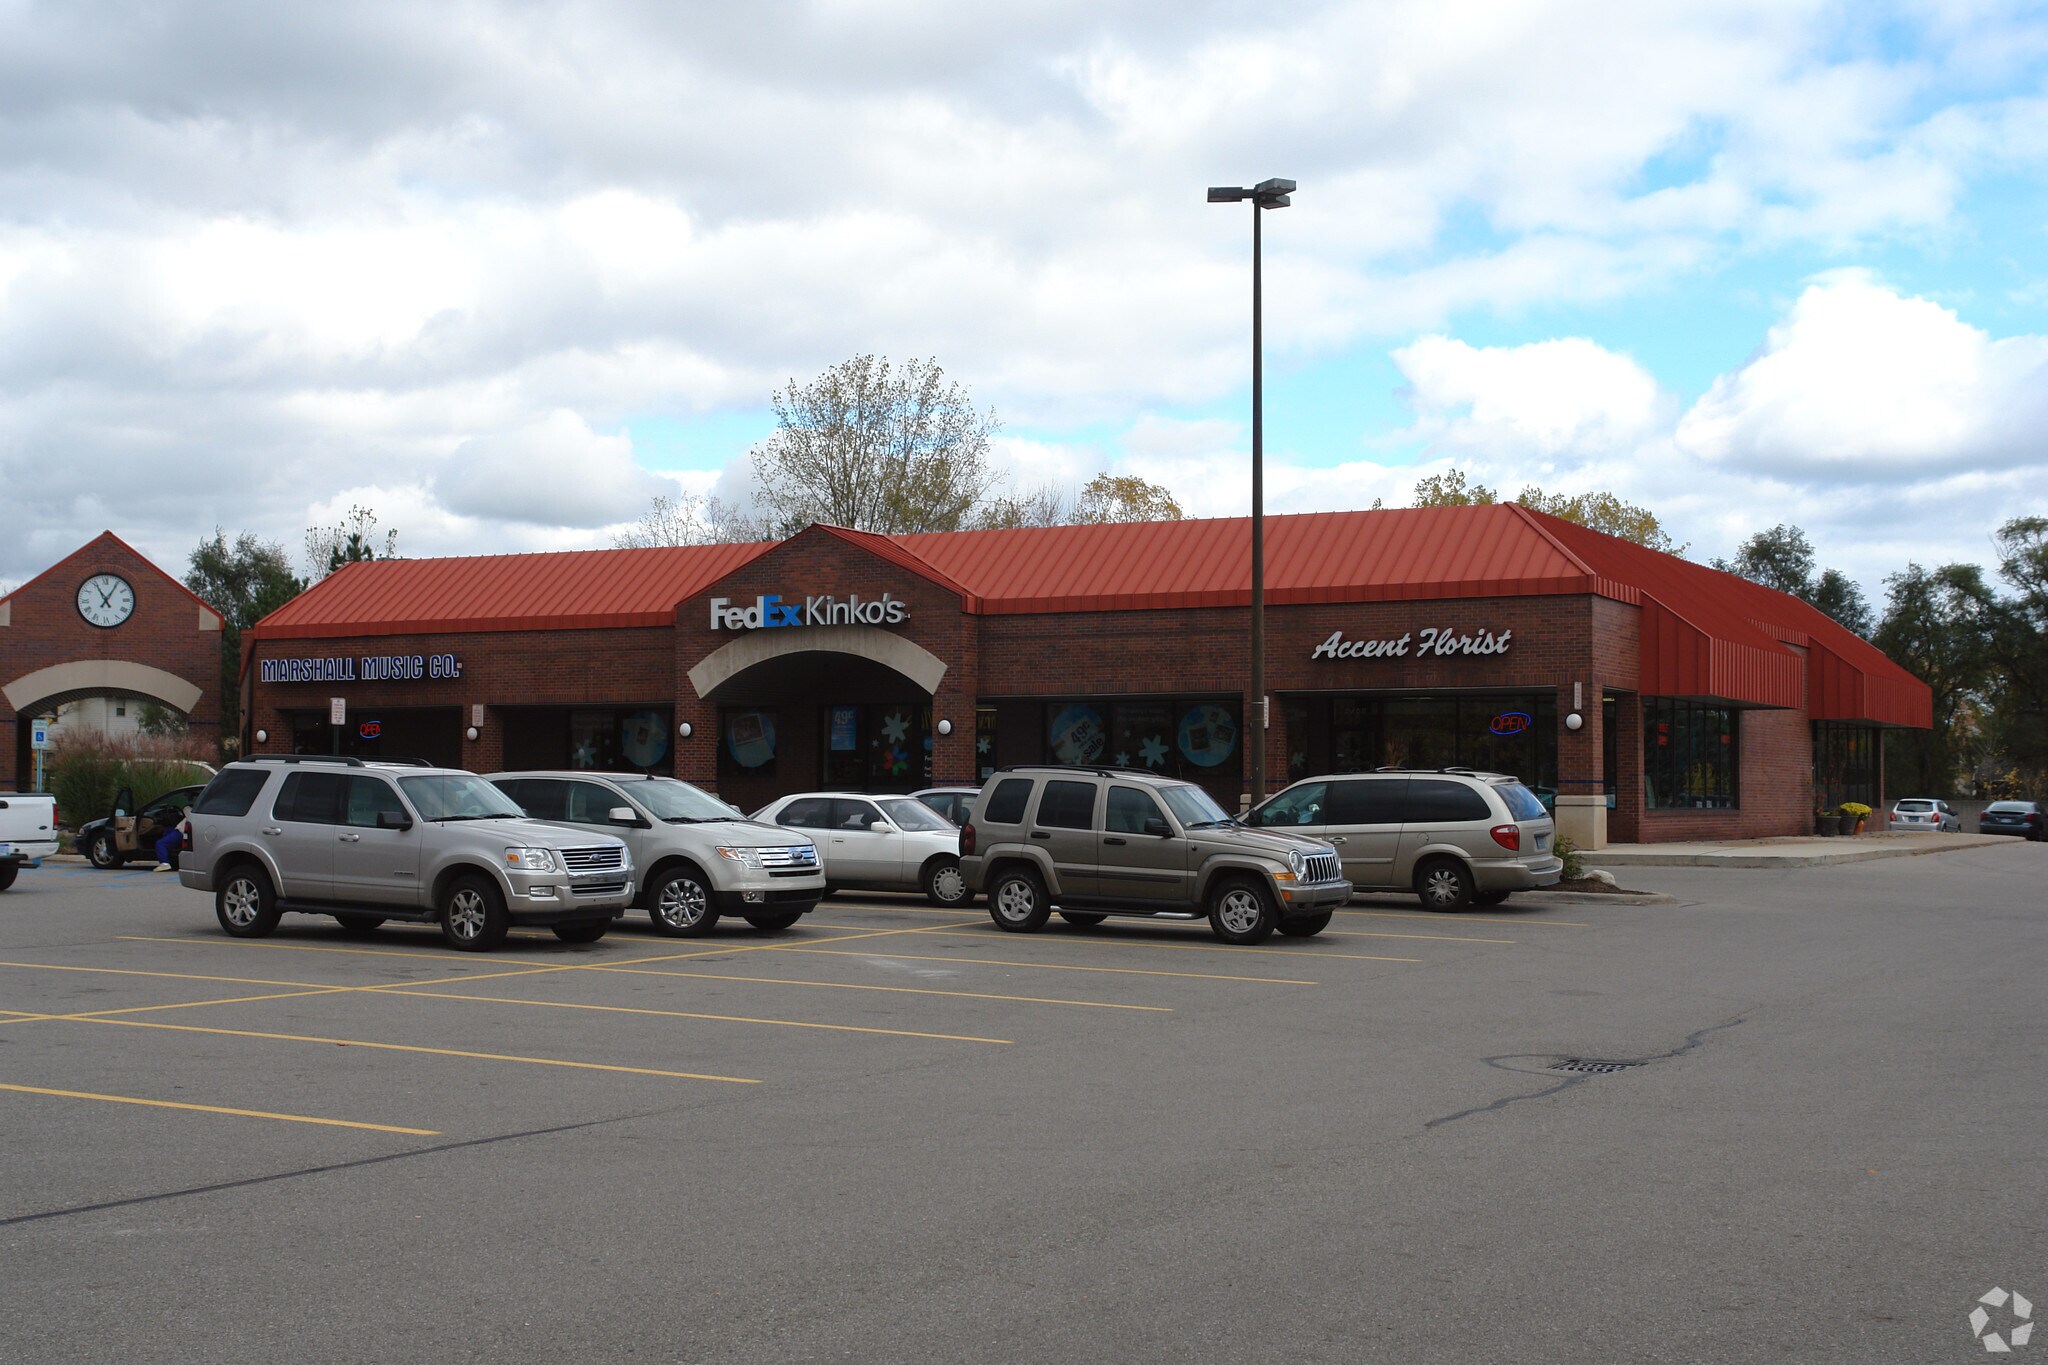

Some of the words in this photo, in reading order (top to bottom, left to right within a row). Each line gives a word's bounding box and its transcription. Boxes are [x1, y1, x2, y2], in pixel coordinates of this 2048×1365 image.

[710, 595, 804, 630] FedEx
[806, 593, 906, 625] Kinko's
[1311, 630, 1411, 659] Accent
[1416, 627, 1511, 657] Florist
[261, 657, 355, 682] MARSHALL
[361, 655, 423, 680] MUSIC
[429, 654, 460, 679] CO.
[1491, 716, 1529, 732] OPEN
[1083, 737, 1104, 758] sale
